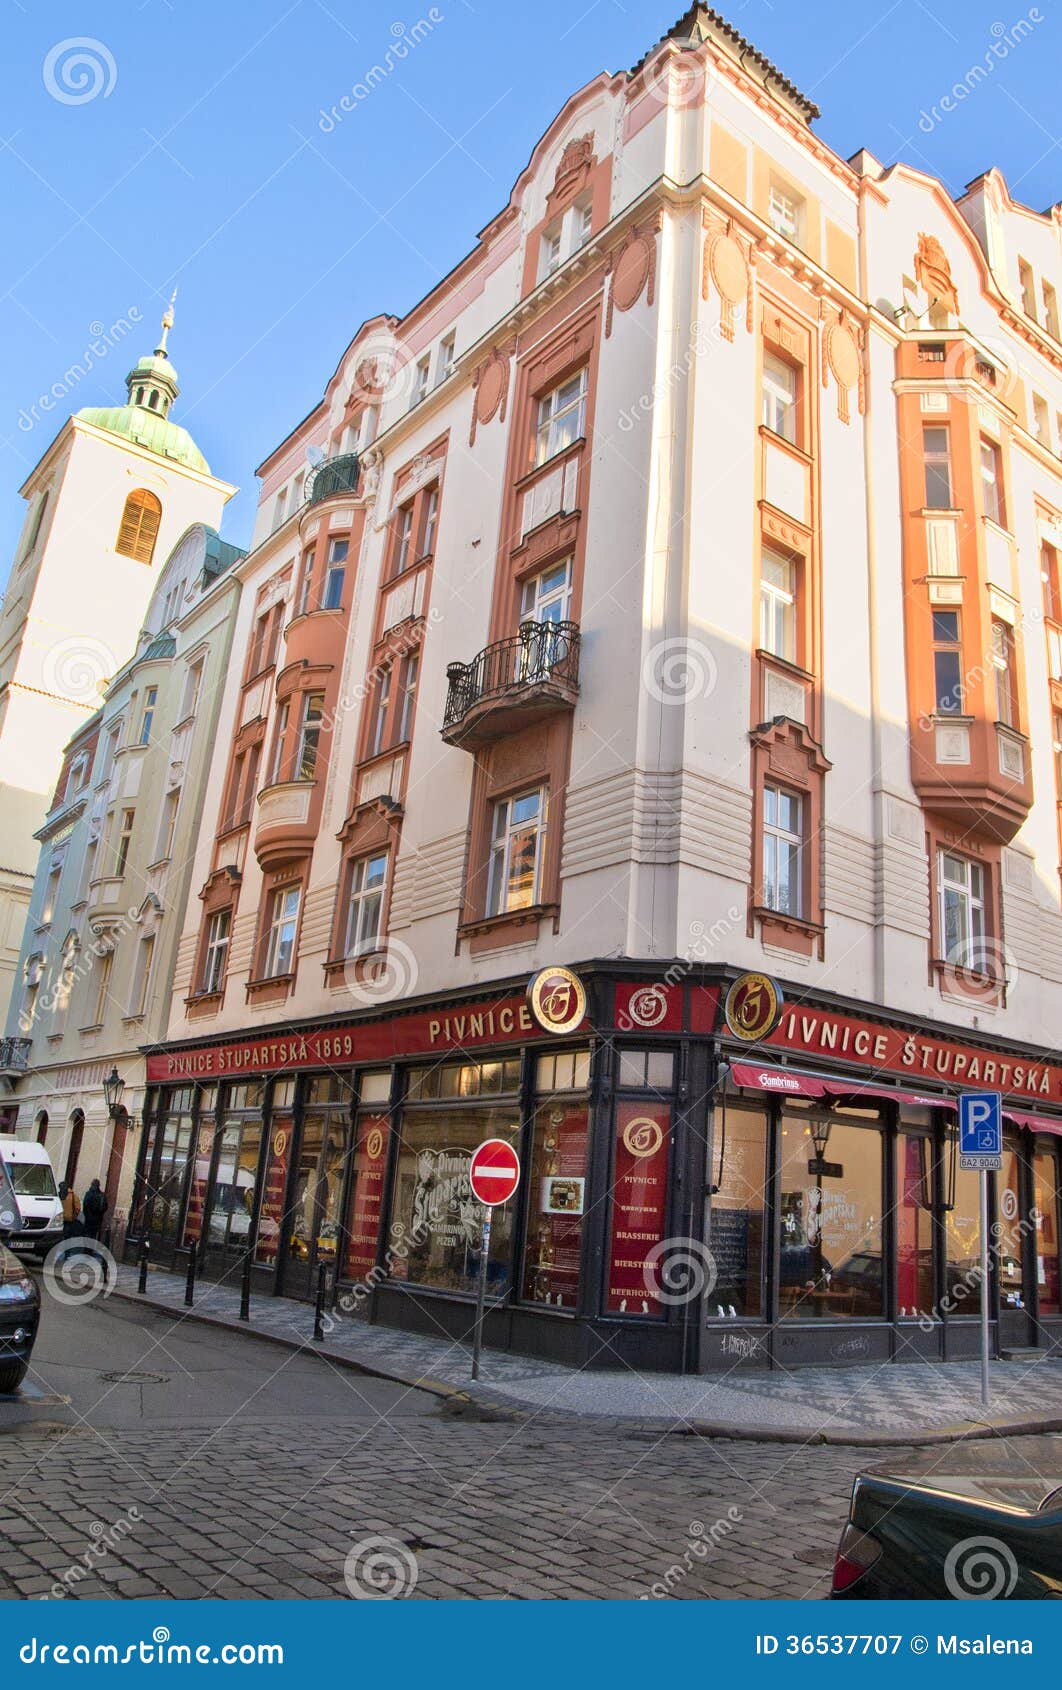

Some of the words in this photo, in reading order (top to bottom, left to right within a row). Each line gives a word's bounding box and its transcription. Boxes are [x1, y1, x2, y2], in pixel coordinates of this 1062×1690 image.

[429, 1005, 533, 1044] PIVNICE
[167, 1053, 213, 1074] PIVNICE
[218, 1037, 308, 1069] ŠTUPARTSKÁ
[315, 1035, 353, 1059] 1869
[779, 1014, 889, 1060] IVNICE
[902, 1036, 1050, 1094] ŠTUPARTSKÁ
[758, 1073, 800, 1089] Gambrinus
[968, 1101, 990, 1134] P
[961, 1159, 977, 1167] 6A2
[980, 1159, 999, 1167] 9040
[624, 1176, 658, 1185] PIVNICE
[616, 1231, 660, 1241] BRASSERIE
[614, 1260, 659, 1270] BIERSTUBE
[611, 1288, 660, 1298] BEERHOUSE
